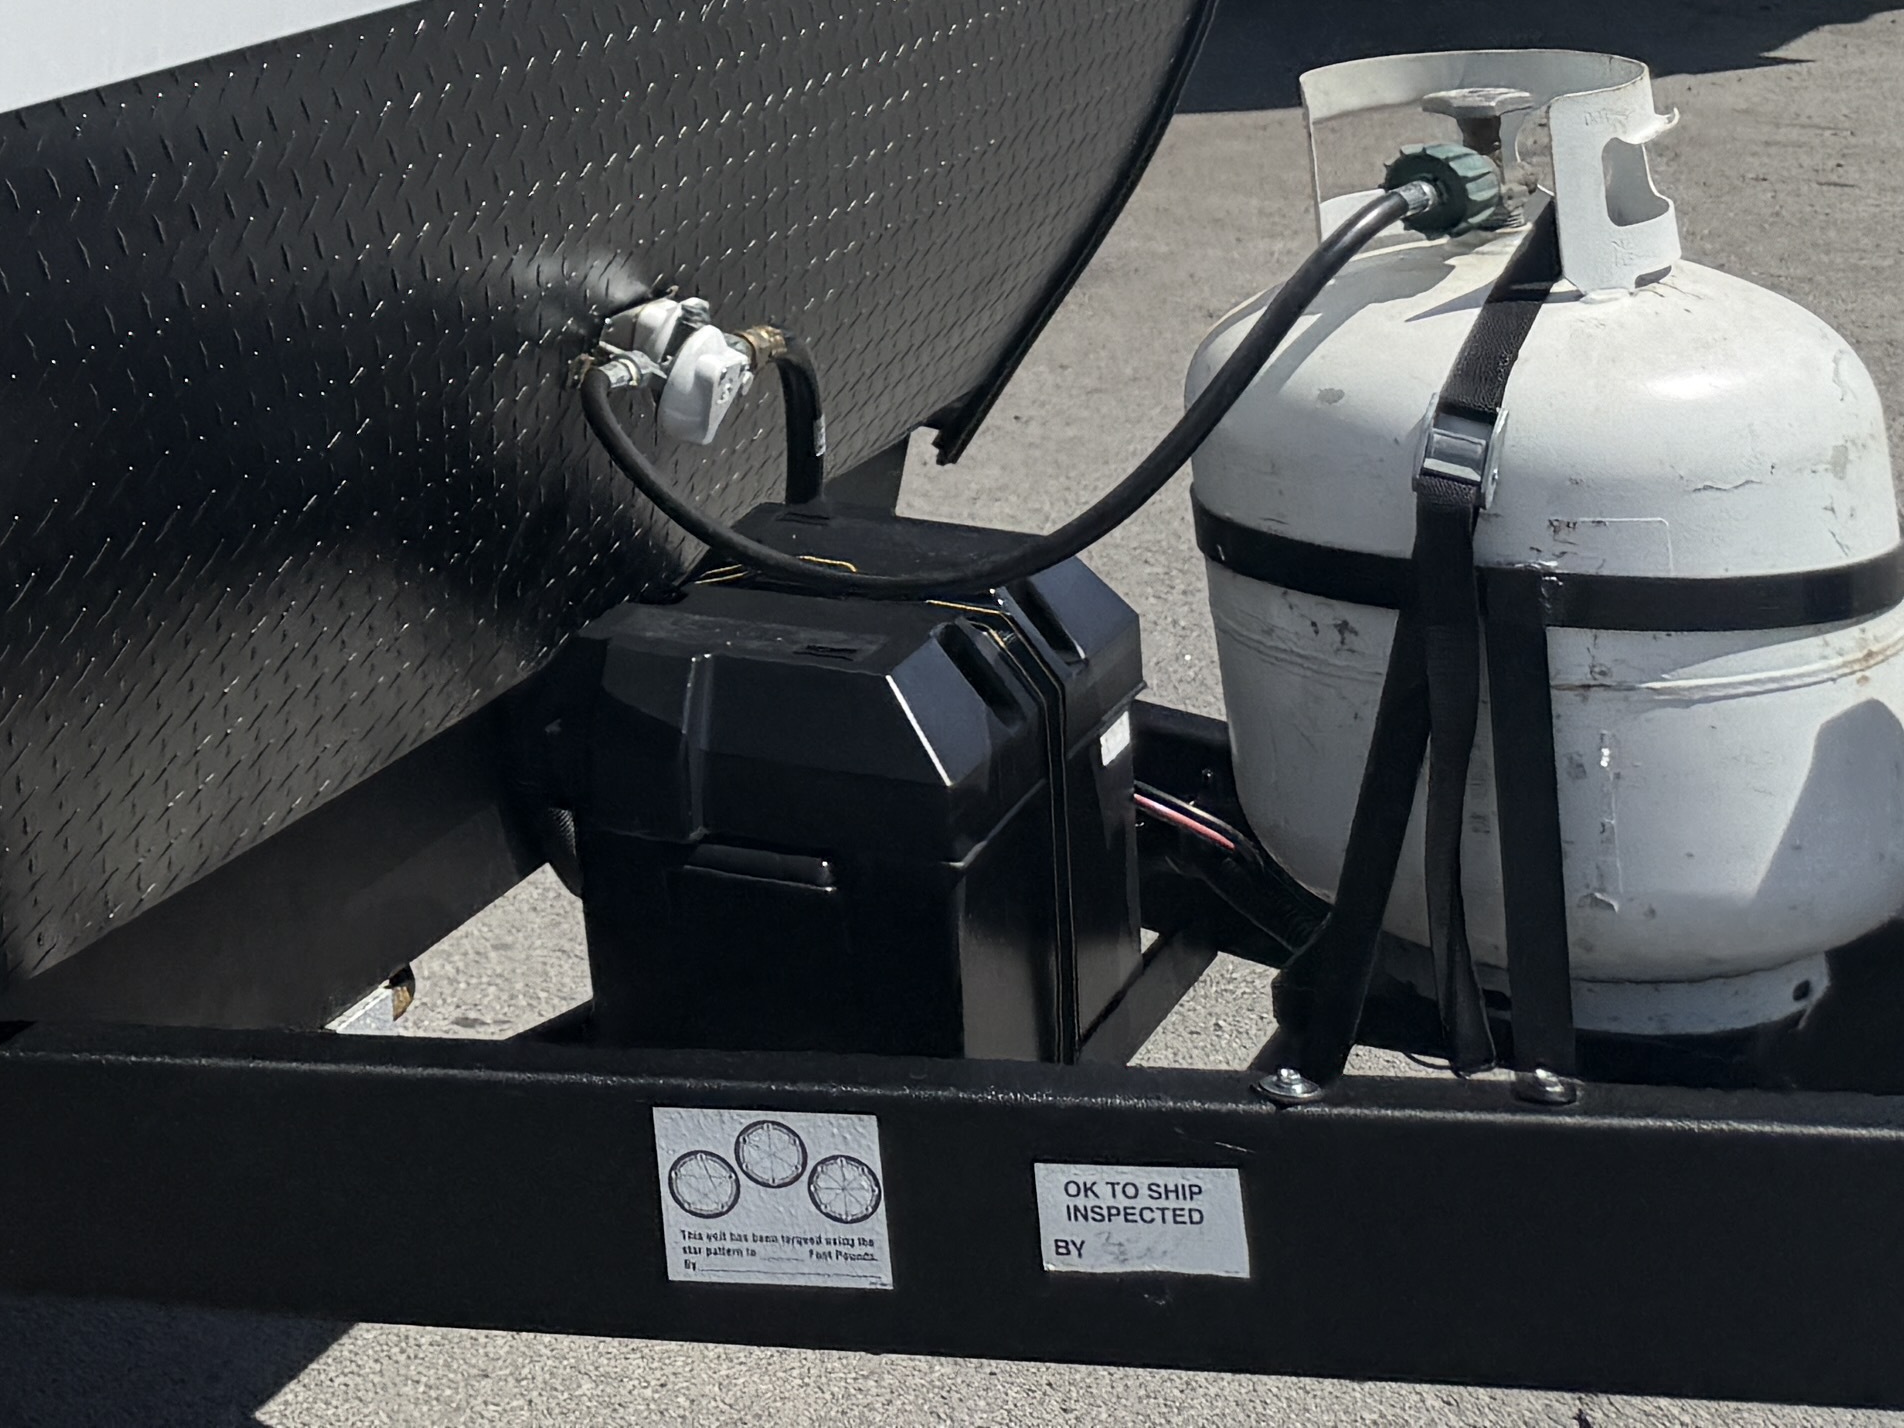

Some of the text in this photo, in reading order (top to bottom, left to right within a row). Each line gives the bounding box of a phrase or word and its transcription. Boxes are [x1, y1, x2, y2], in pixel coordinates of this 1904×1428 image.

[1063, 1180, 1203, 1201] OK TO SHIP
[1066, 1204, 1204, 1225] INSPECTED
[1054, 1238, 1086, 1258] BY
